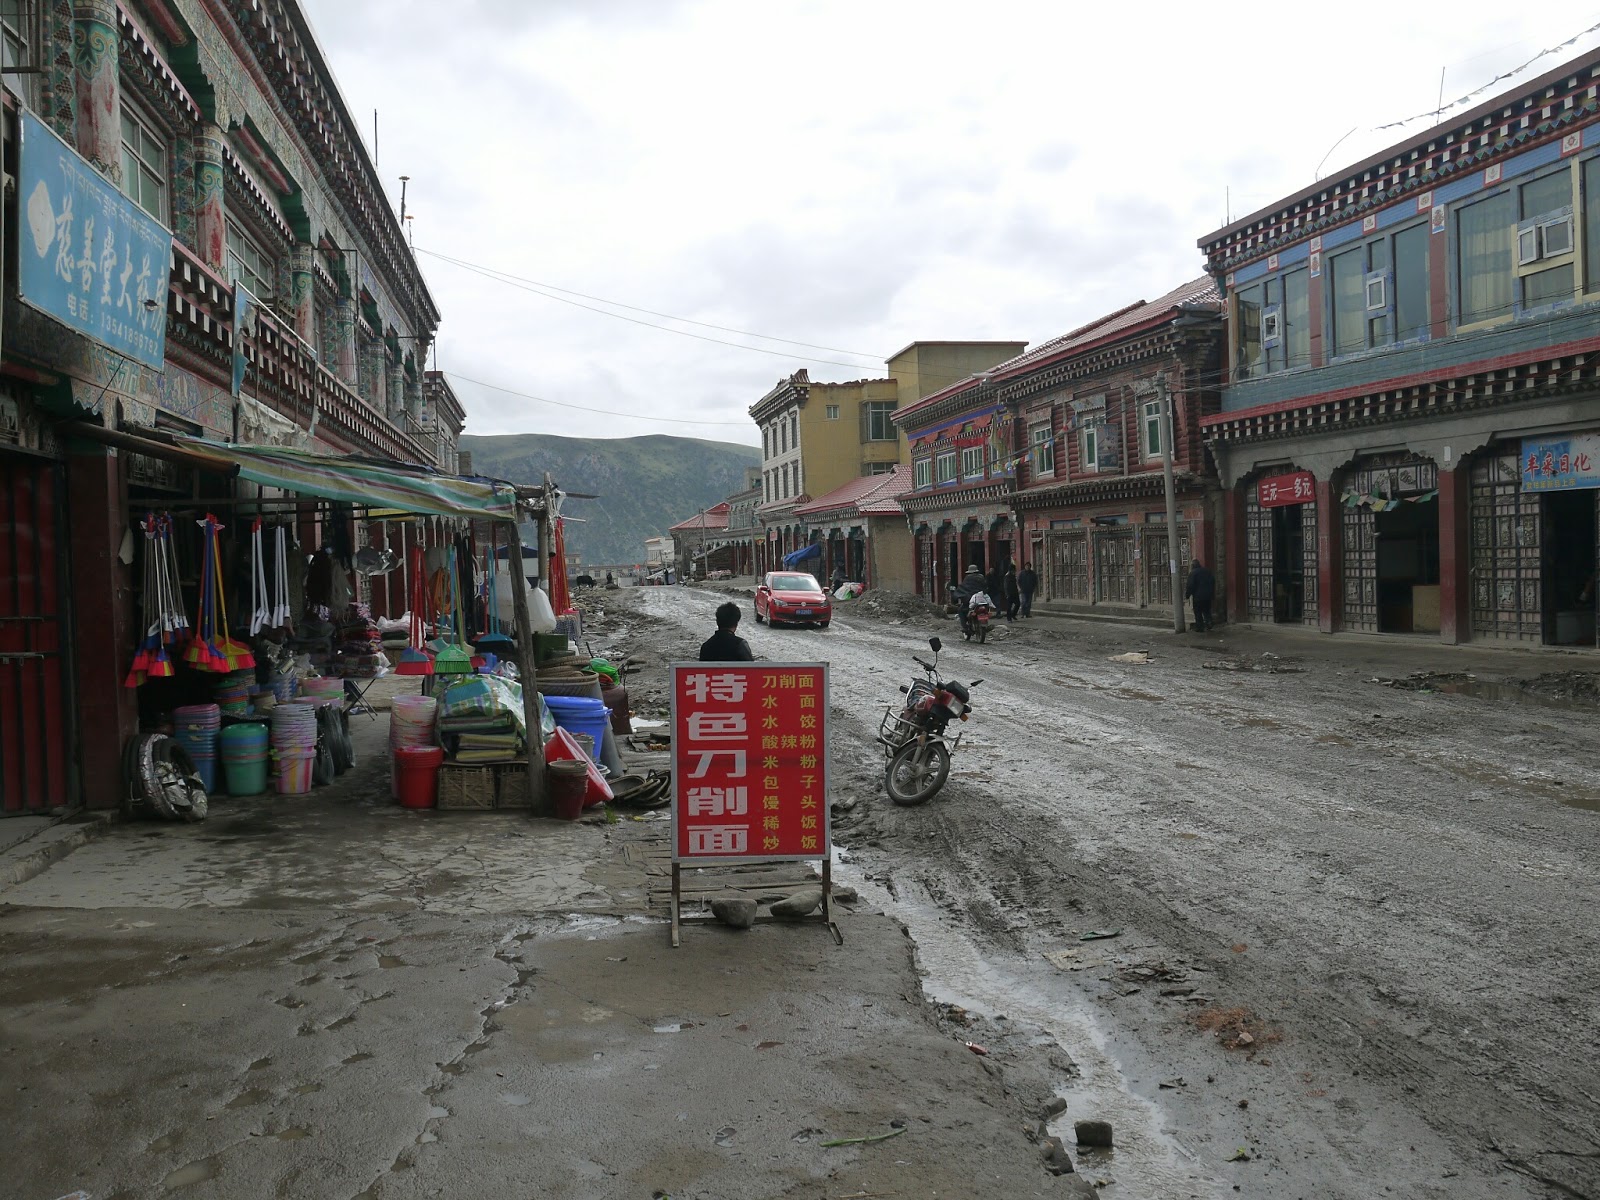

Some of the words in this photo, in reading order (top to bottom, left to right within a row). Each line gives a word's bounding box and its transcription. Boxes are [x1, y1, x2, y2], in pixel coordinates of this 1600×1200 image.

[762, 674, 814, 688] 刀削面
[762, 734, 816, 750] 酸辣粉
[685, 673, 749, 854] 特色刀削面
